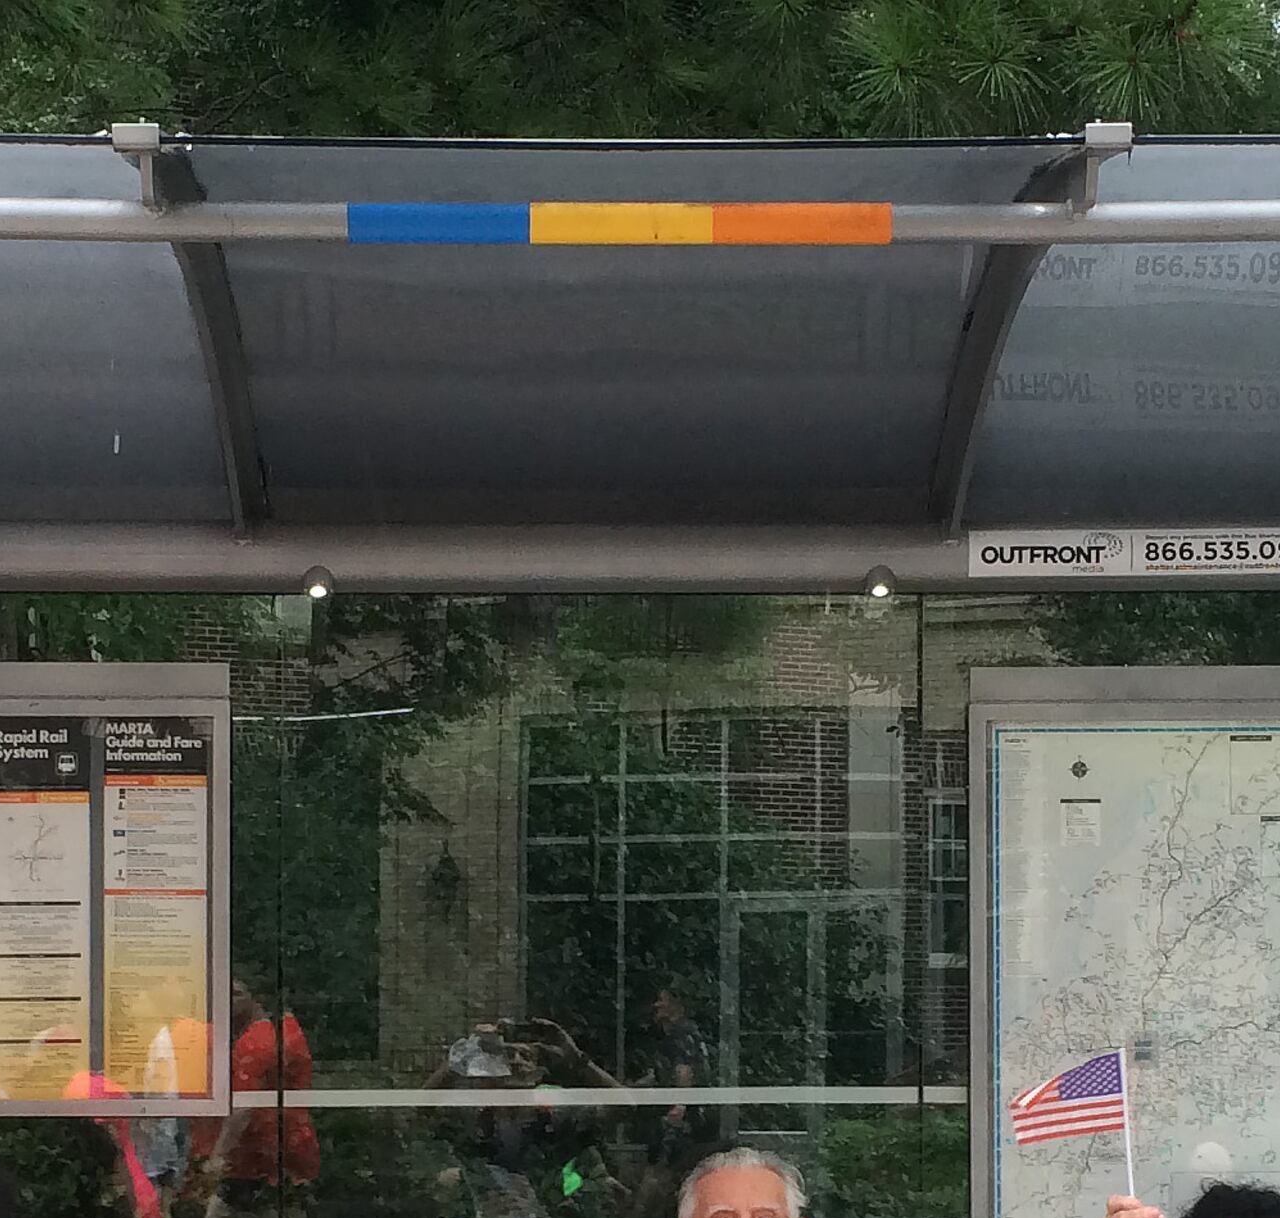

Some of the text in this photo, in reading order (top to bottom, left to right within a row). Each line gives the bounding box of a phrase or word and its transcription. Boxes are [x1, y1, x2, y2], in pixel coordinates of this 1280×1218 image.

[981, 546, 1107, 564] OUTFRONT
[1072, 565, 1105, 573] media
[105, 722, 154, 735] MARTA
[39, 729, 68, 743] Rail
[106, 735, 203, 749] Guide and Fare
[106, 748, 182, 762] Information
